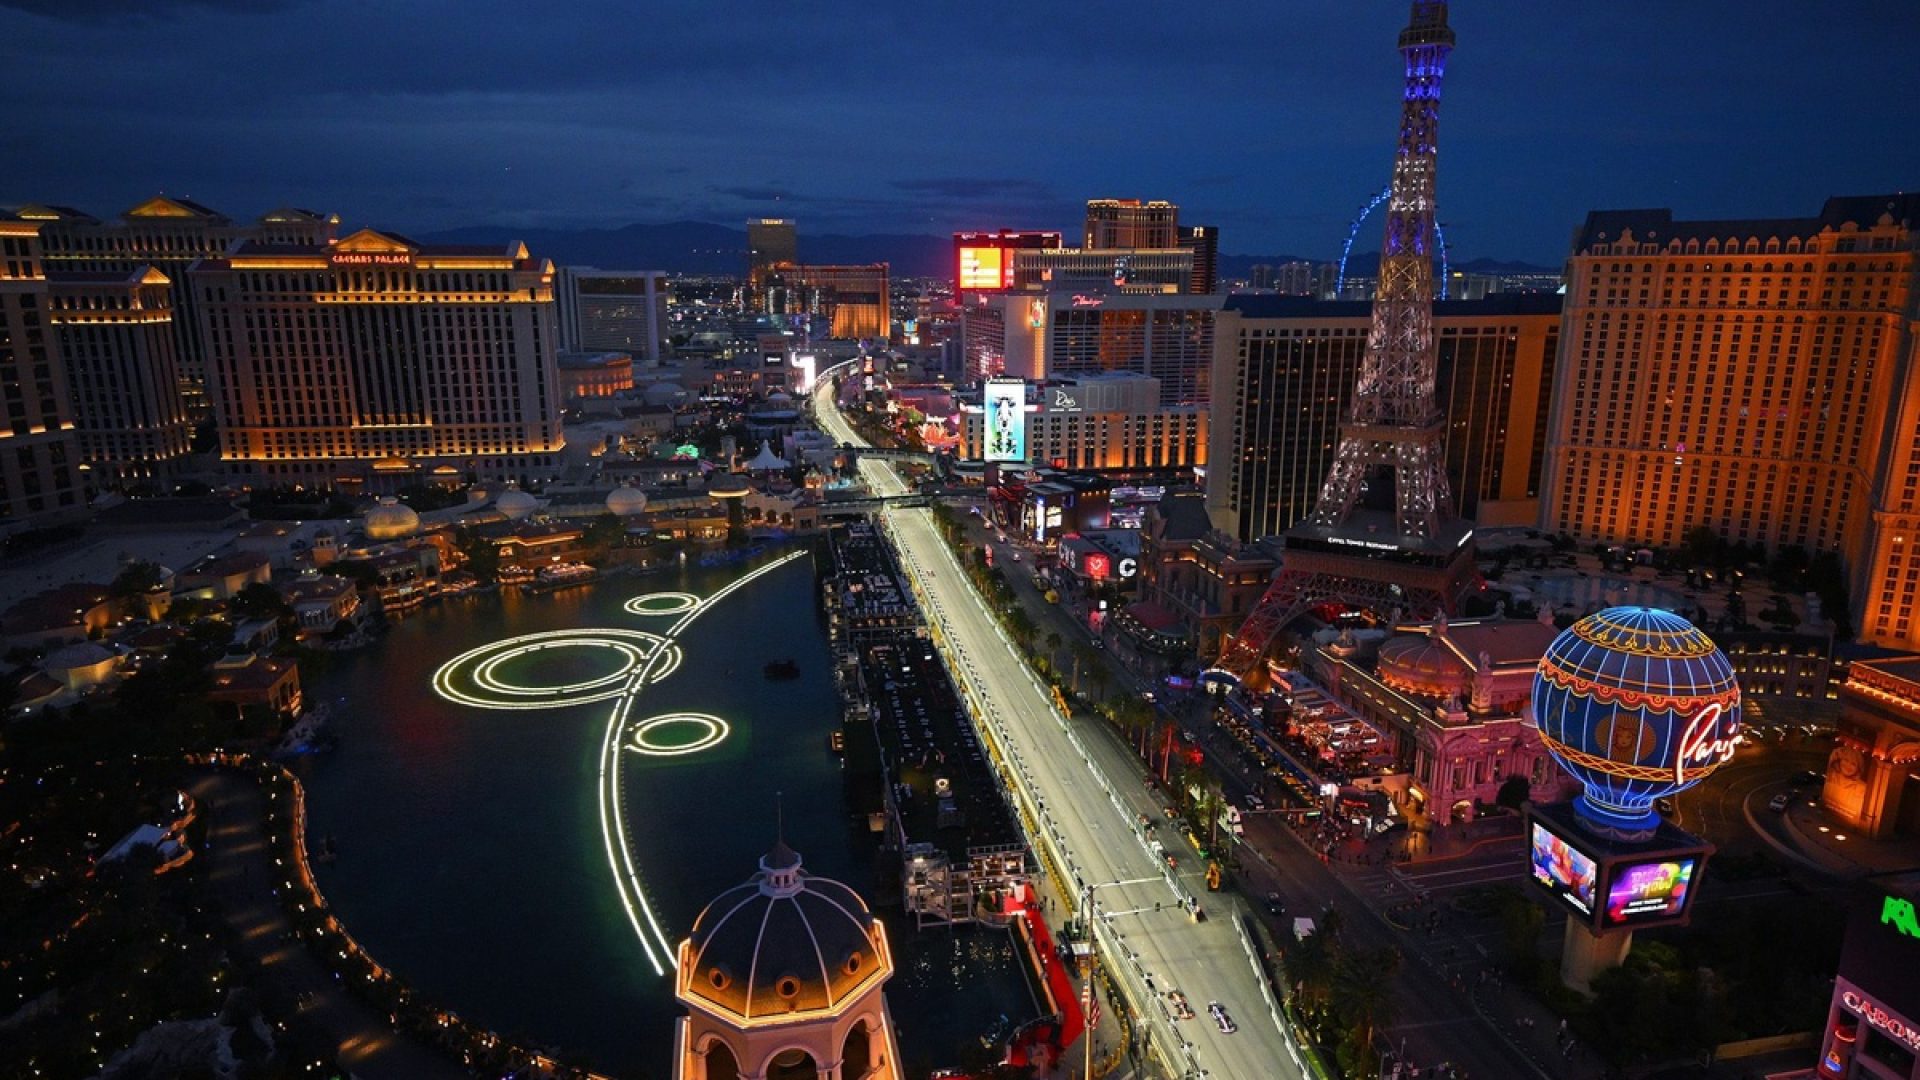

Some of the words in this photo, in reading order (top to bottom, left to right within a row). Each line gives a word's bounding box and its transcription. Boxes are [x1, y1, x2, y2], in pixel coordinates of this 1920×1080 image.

[332, 255, 372, 264] CAESARS
[375, 255, 411, 264] PALACE
[1676, 703, 1743, 785] Paris
